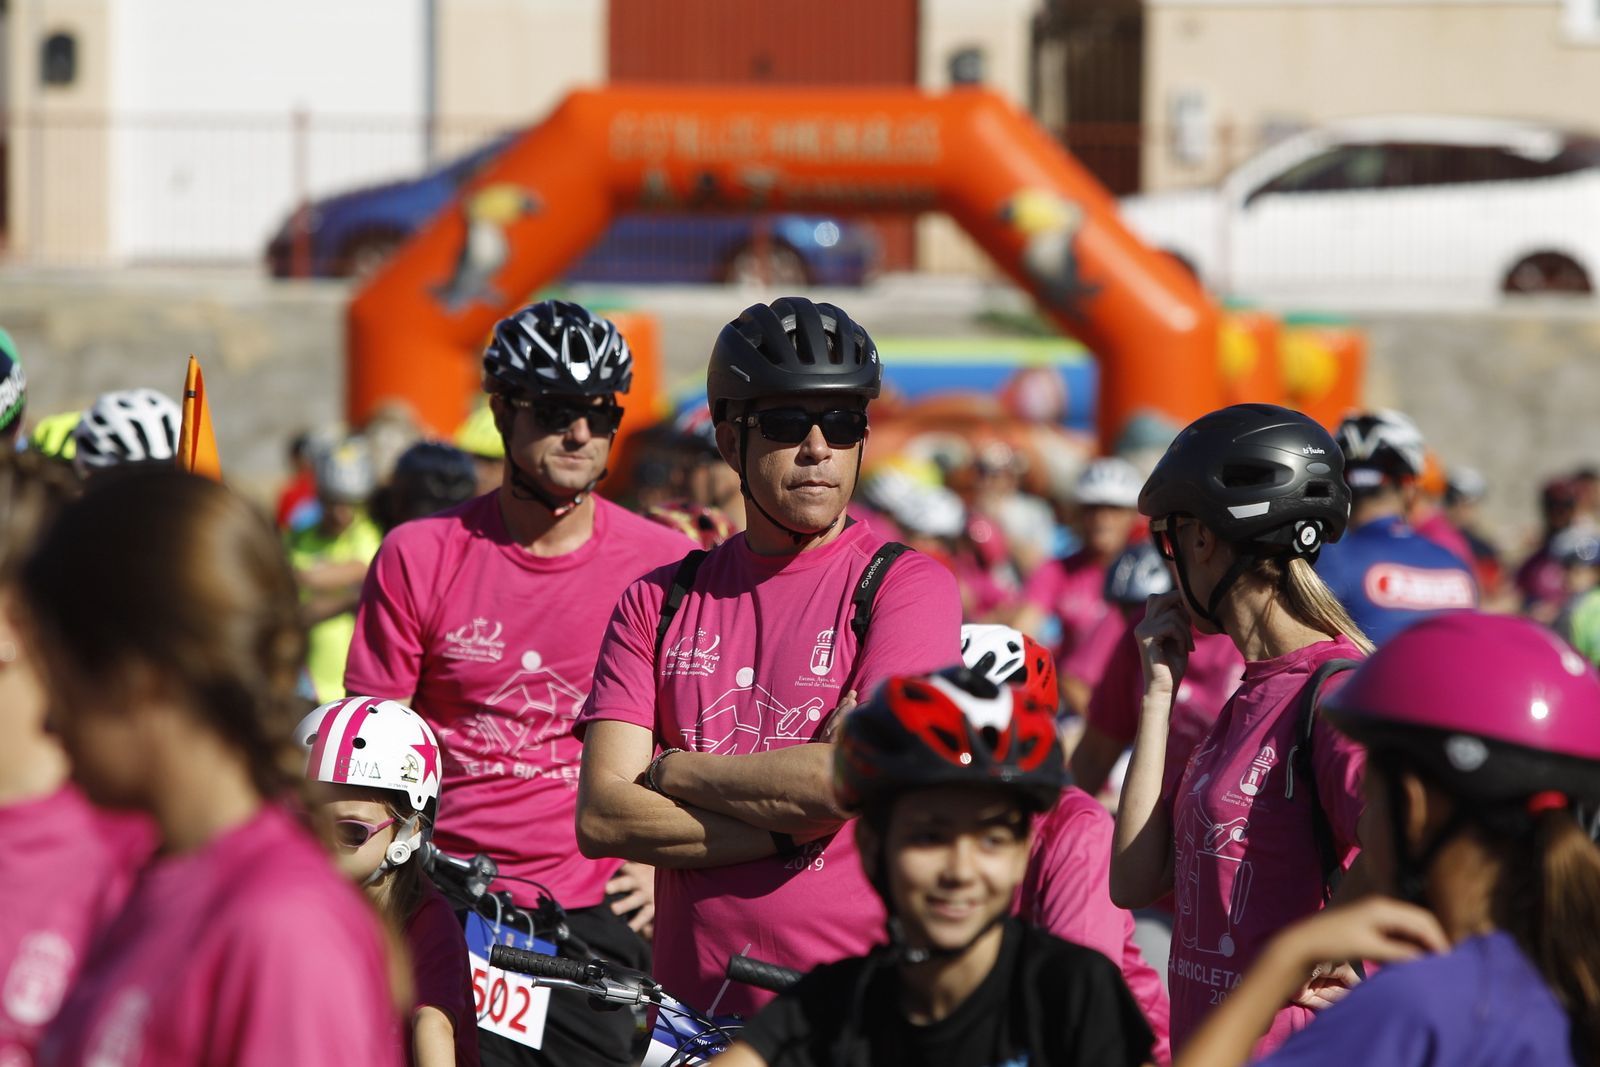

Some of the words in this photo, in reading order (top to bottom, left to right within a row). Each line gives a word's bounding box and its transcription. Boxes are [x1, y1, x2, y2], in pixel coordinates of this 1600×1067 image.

[784, 857, 824, 872] 2019
[1178, 957, 1244, 990] BICICLETA
[472, 967, 531, 1034] 502
